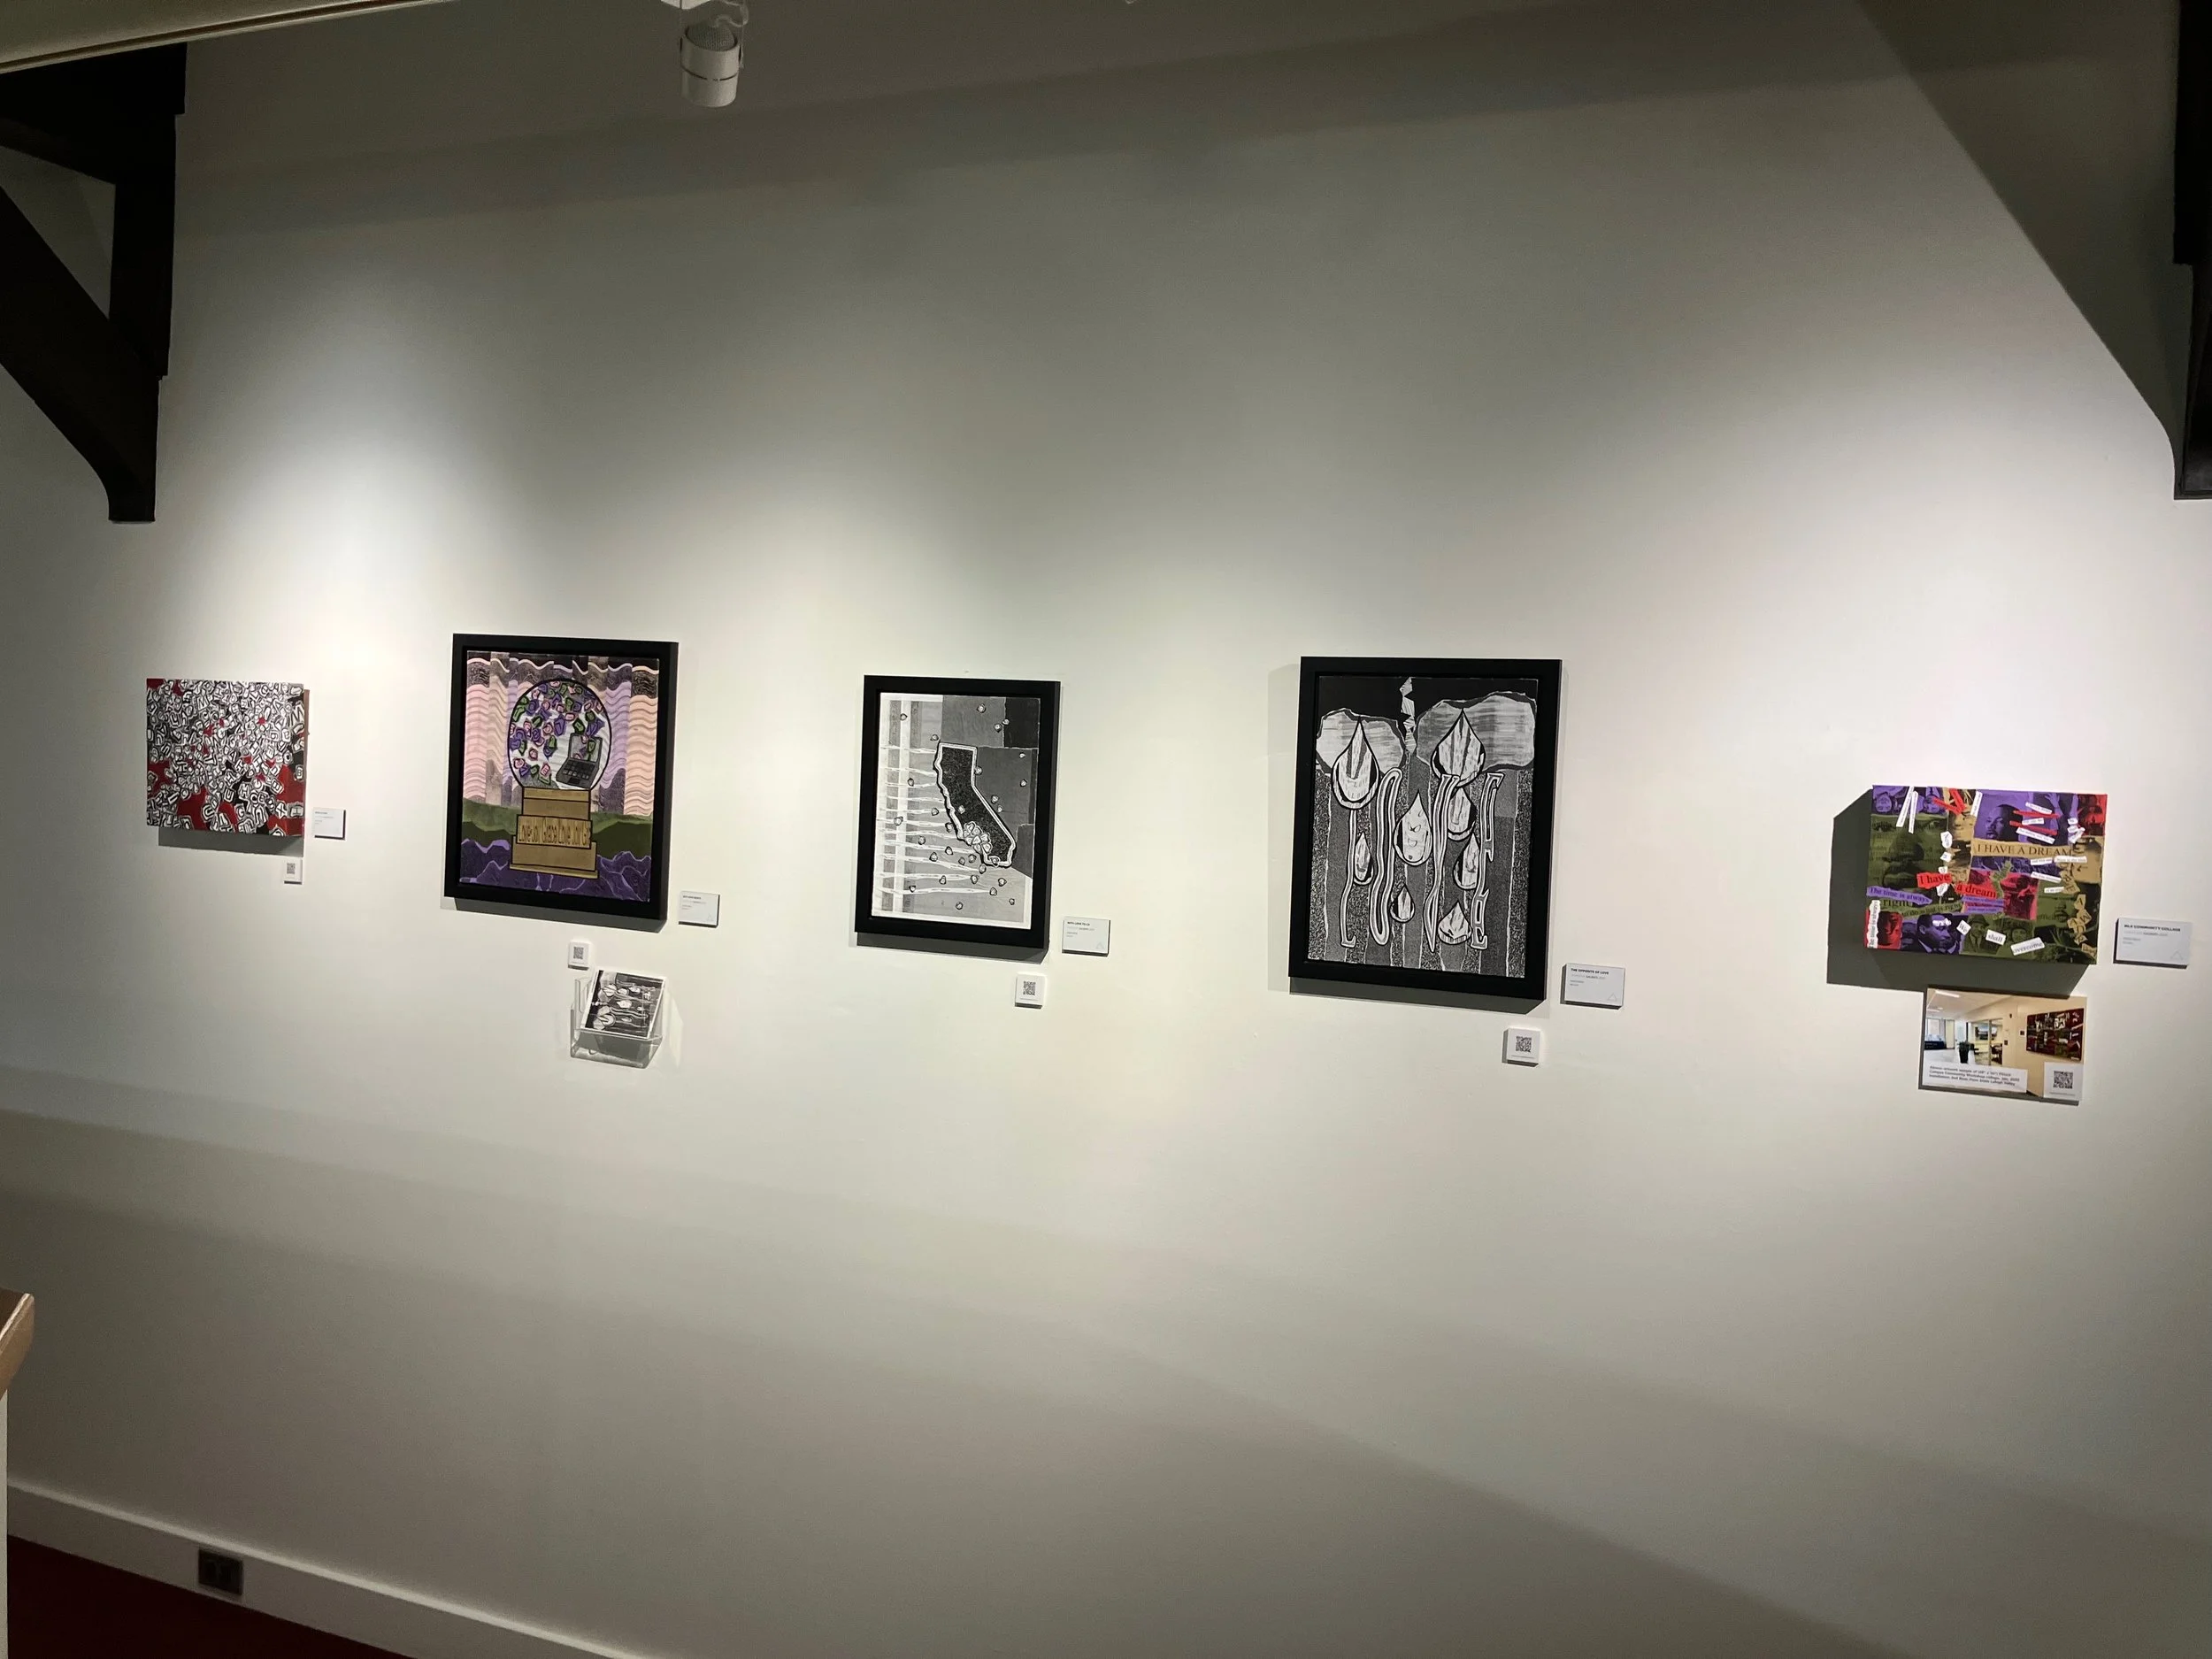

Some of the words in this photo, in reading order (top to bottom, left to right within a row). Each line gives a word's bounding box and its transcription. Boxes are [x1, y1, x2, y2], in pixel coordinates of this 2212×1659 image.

[1978, 844, 1981, 853] I
[1985, 844, 2013, 854] HAVE
[2017, 846, 2025, 855] A
[2029, 847, 2072, 856] DREAM
[1926, 873, 1950, 883] have
[1883, 888, 1897, 897] time
[1906, 893, 1930, 902] always
[1965, 885, 1996, 898] dream
[1987, 933, 2003, 942] shall
